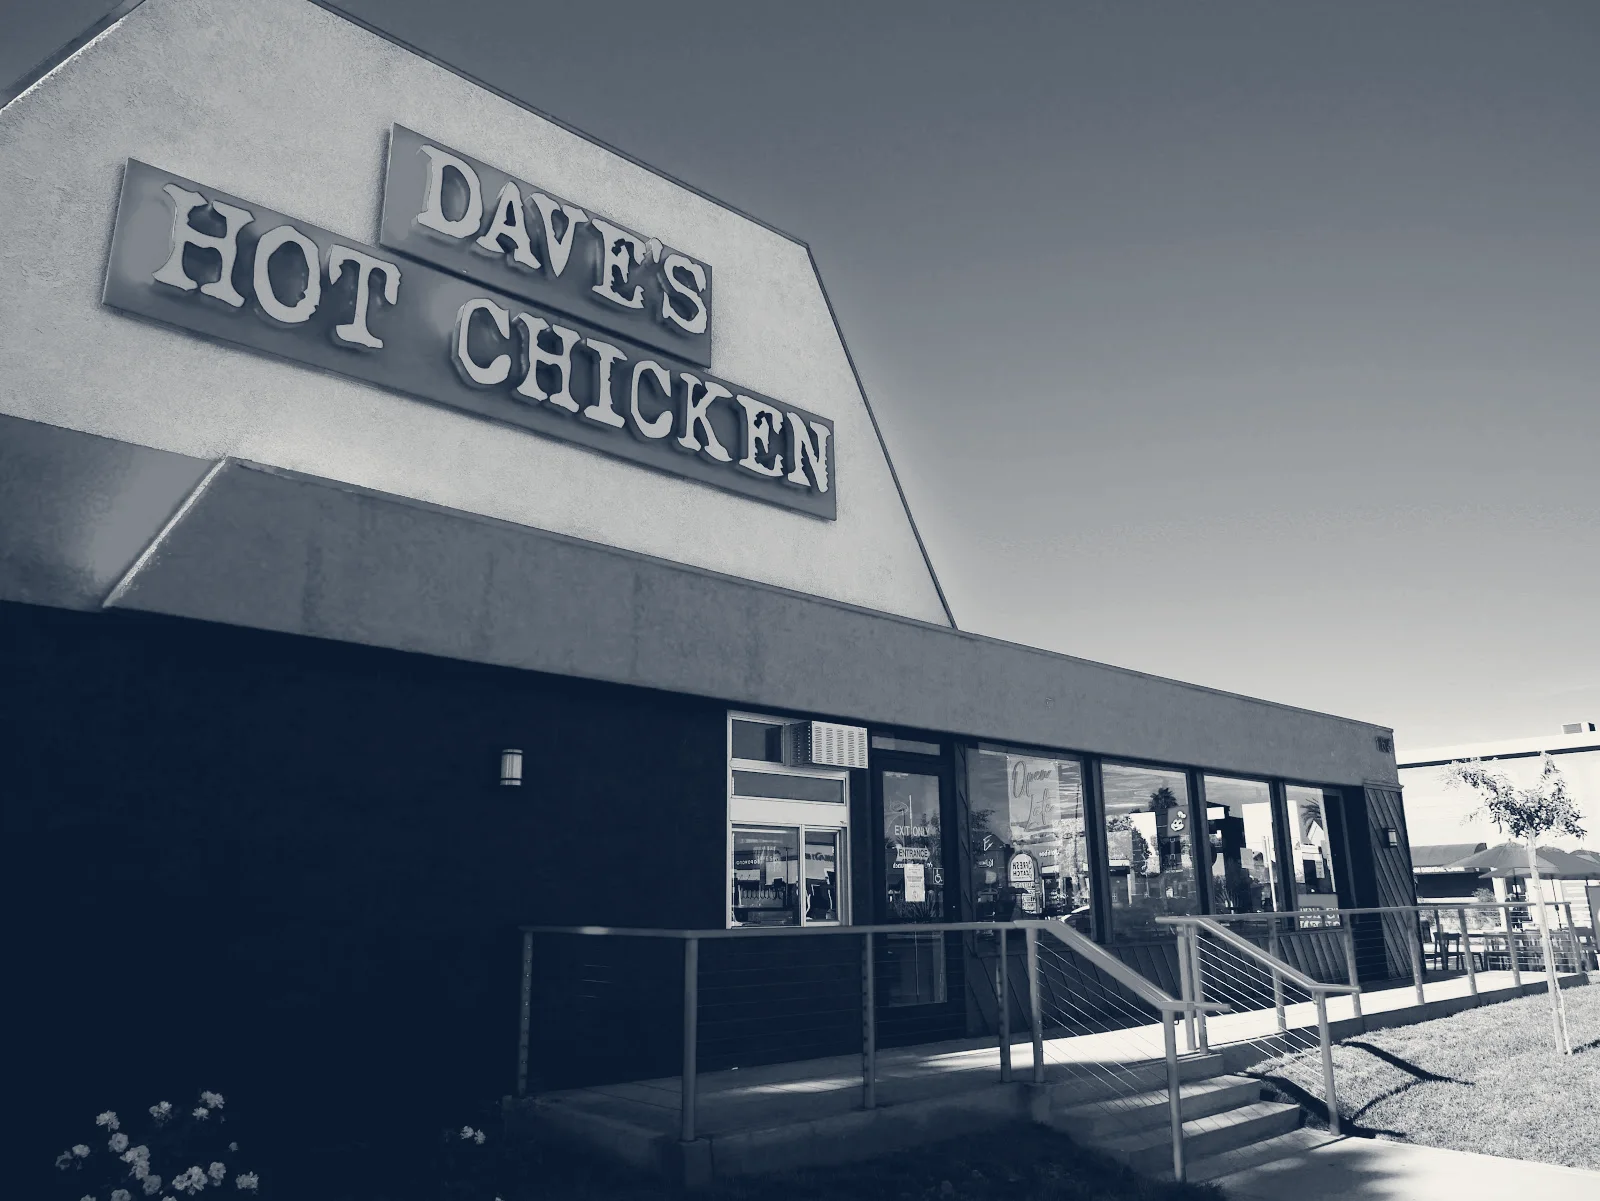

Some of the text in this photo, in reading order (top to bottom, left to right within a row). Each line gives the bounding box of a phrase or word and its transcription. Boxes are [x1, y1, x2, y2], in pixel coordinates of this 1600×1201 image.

[415, 143, 709, 335] DAVE'S
[152, 182, 832, 494] HOT CHICKEN
[894, 825, 930, 837] EXIT ONLY
[898, 848, 928, 858] ENTRANCE
